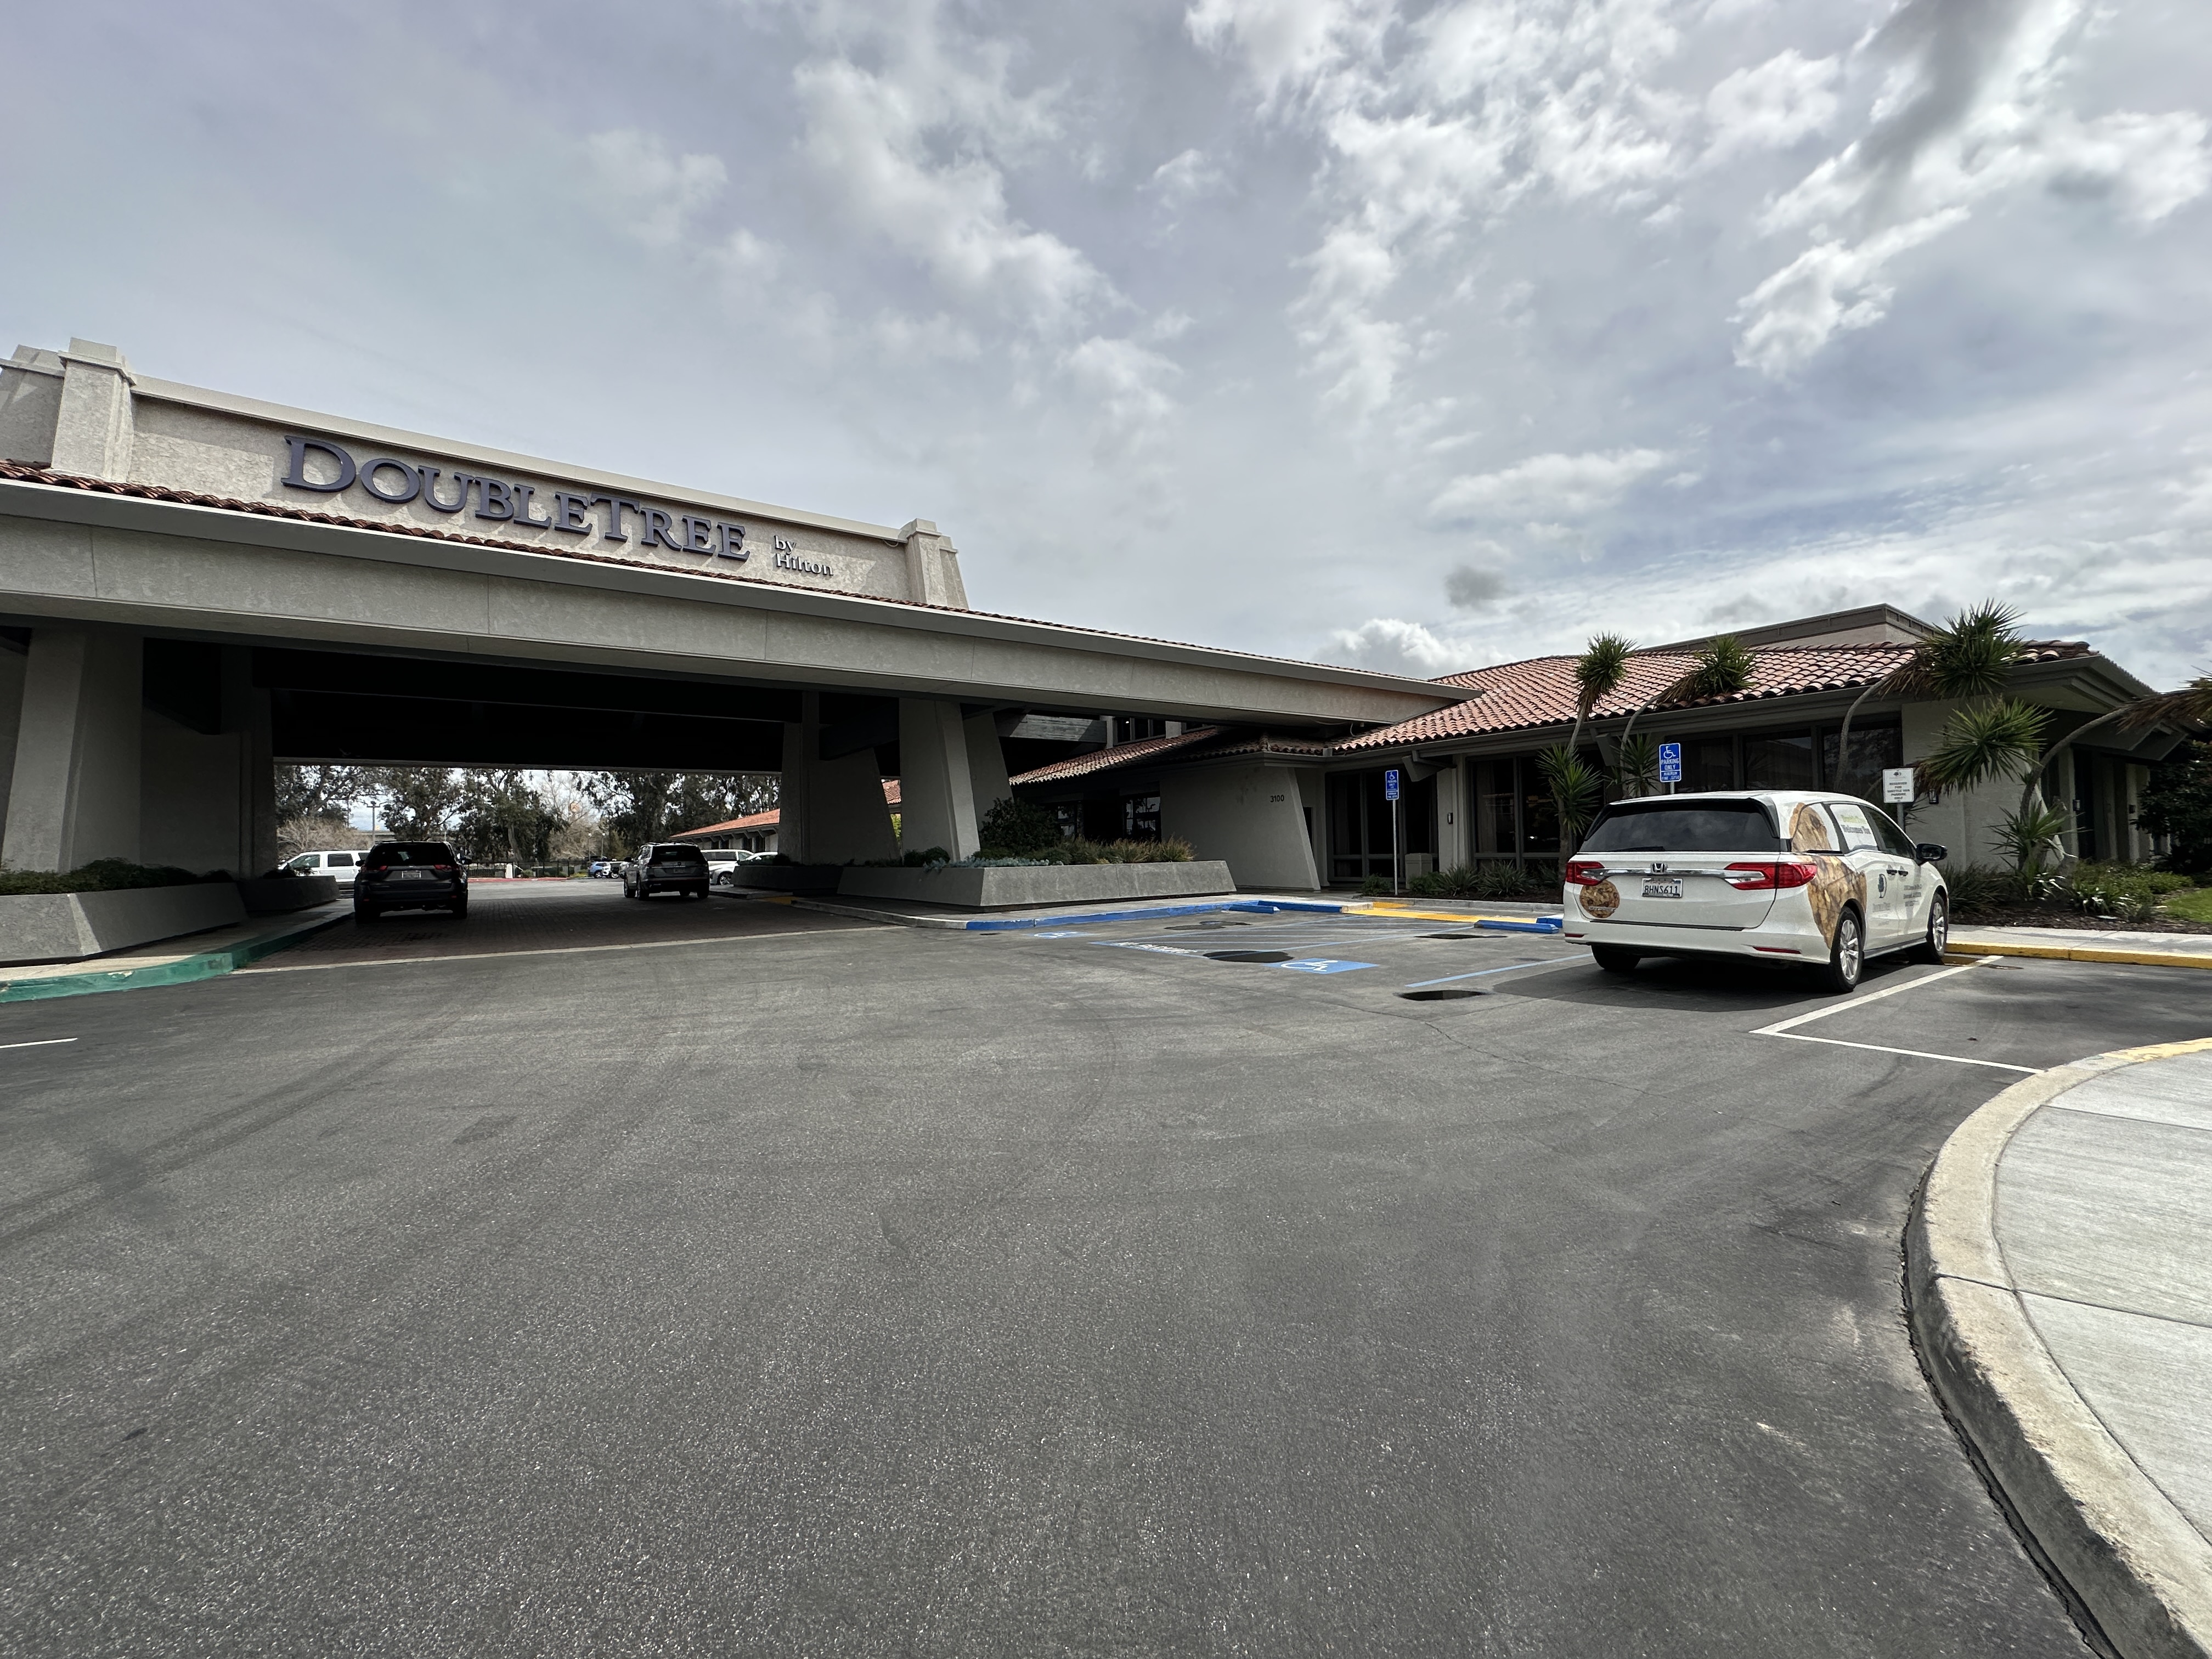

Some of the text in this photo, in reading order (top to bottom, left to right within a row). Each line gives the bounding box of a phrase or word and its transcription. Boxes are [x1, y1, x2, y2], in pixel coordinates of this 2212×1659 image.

[280, 435, 751, 562] DOUBLETREE
[774, 535, 797, 555] by
[775, 553, 834, 576] Hilton
[1645, 885, 1678, 894] 8HNS611
